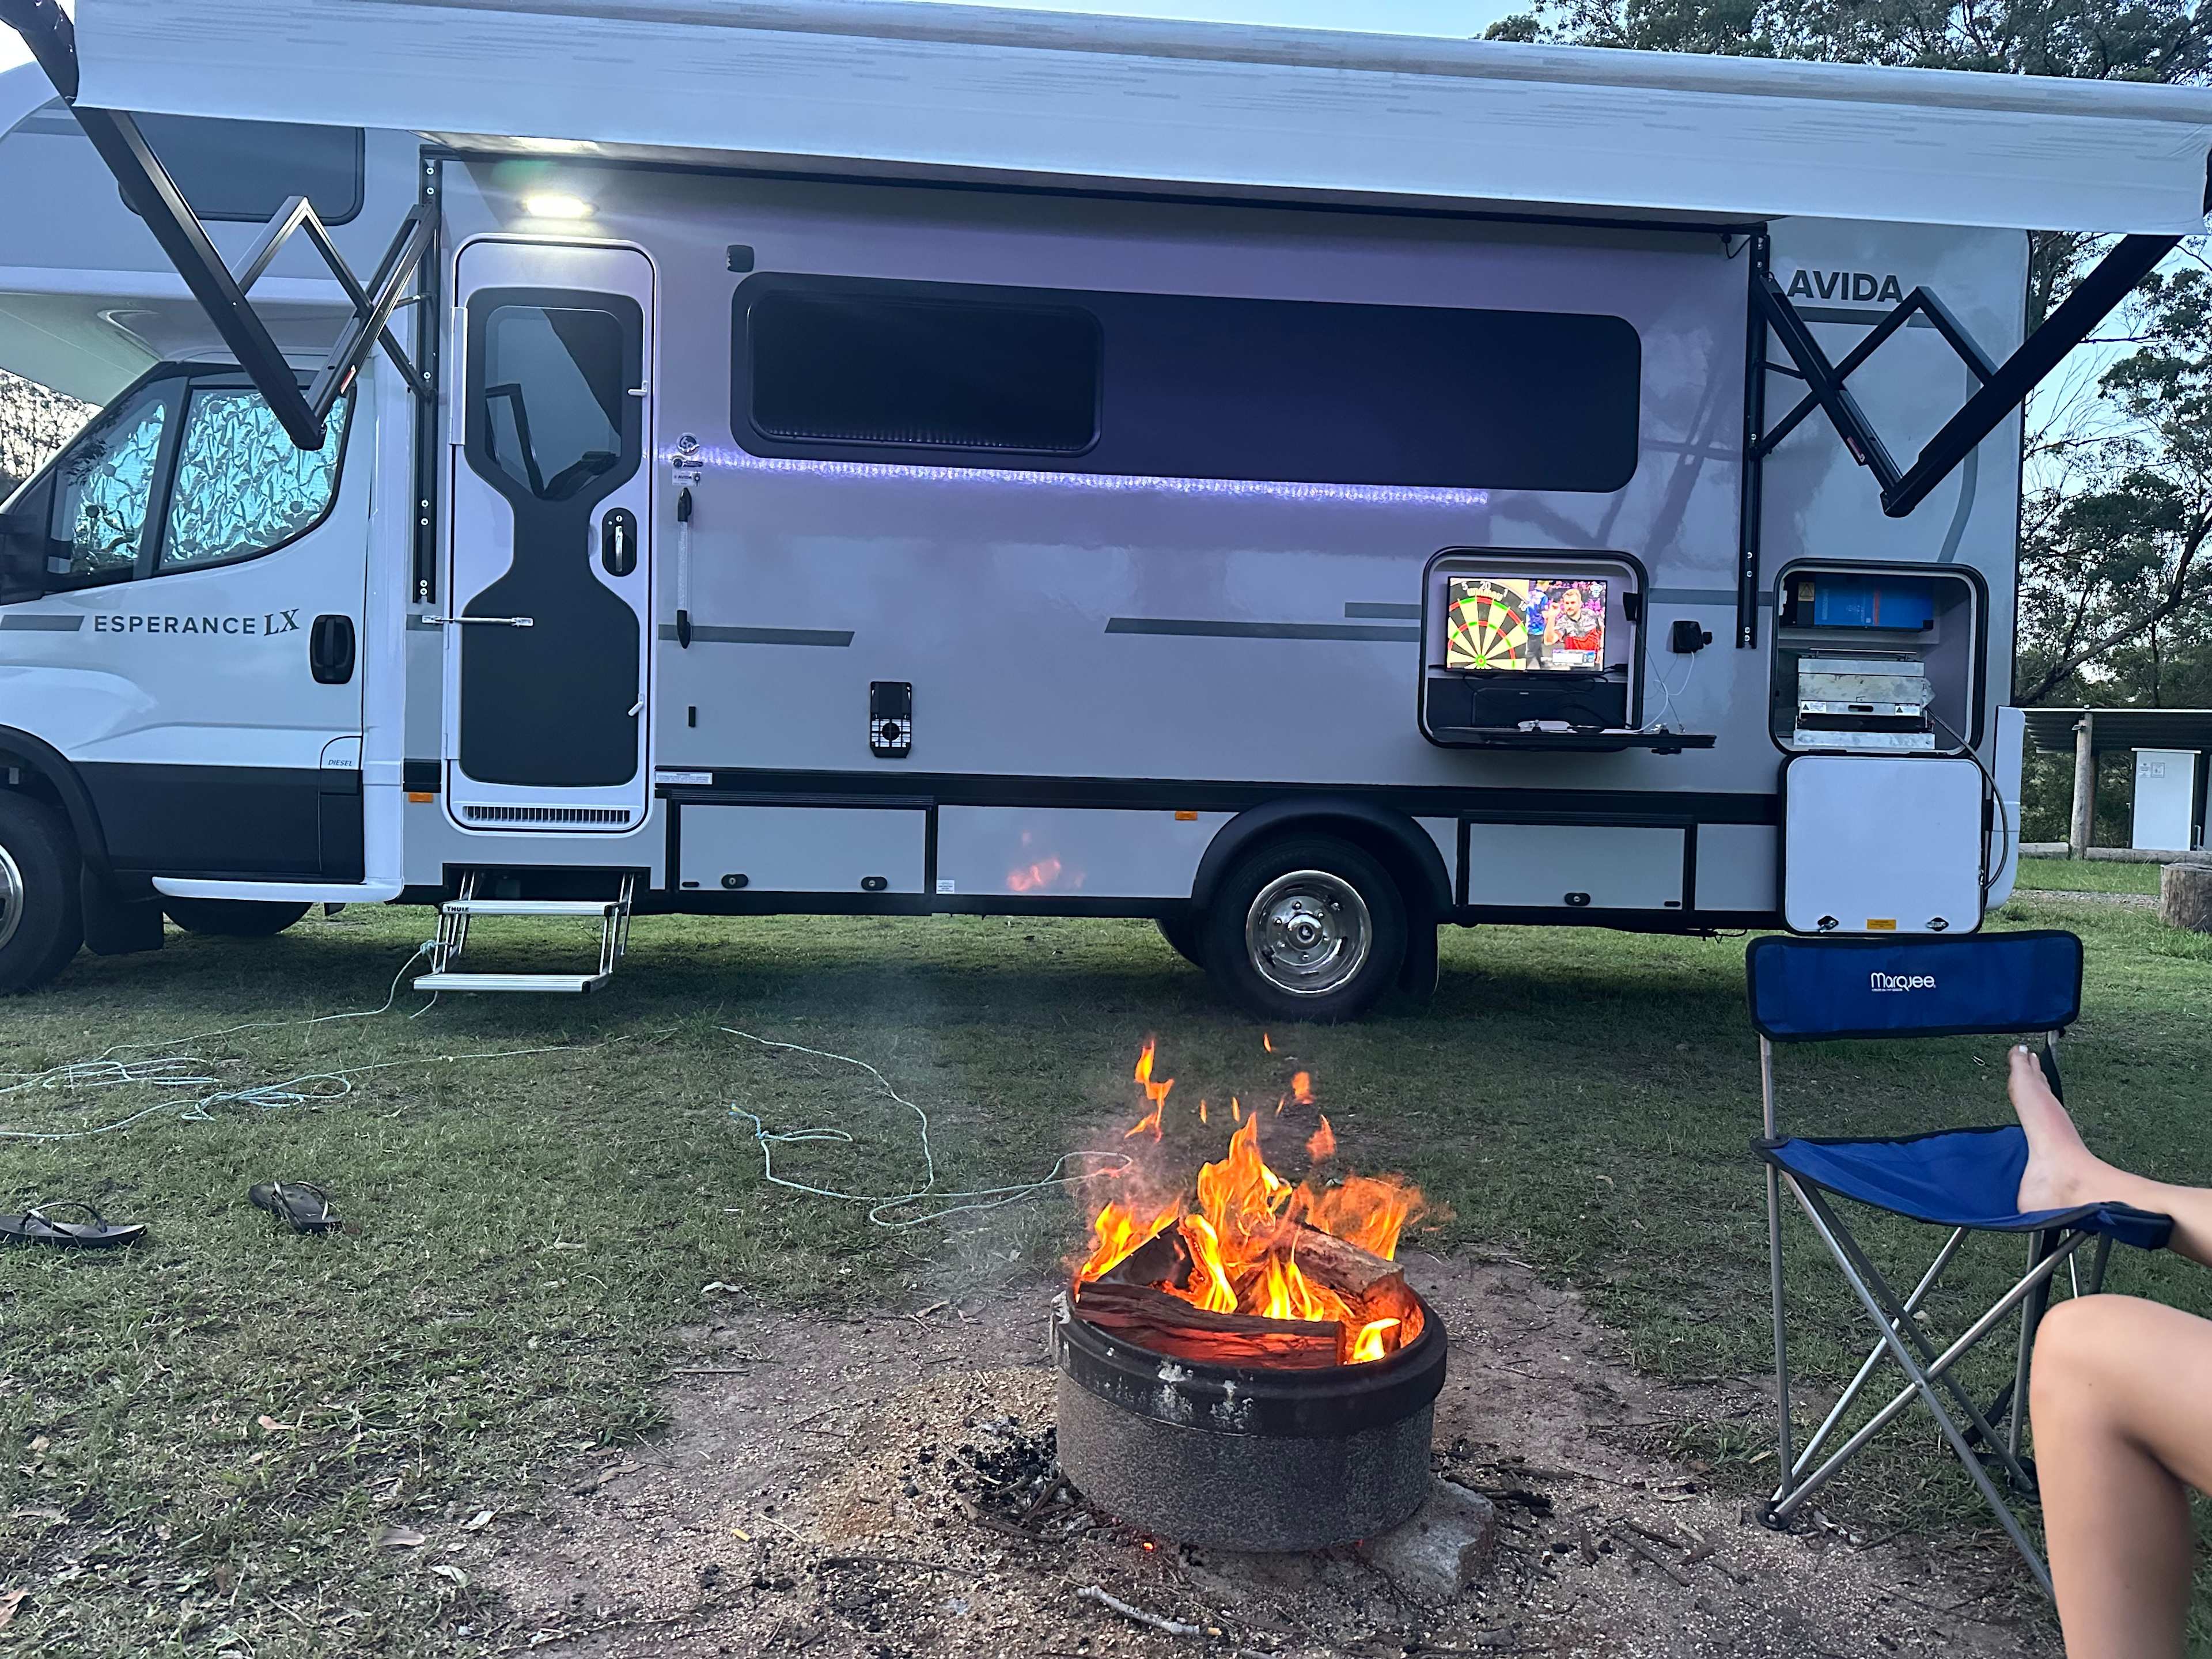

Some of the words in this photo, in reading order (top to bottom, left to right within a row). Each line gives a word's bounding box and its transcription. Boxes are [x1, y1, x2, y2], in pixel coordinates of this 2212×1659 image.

[1786, 270, 1904, 303] AVIDA
[1480, 581, 1491, 590] 20
[94, 615, 255, 634] ESPERANCE
[264, 608, 300, 636] LX
